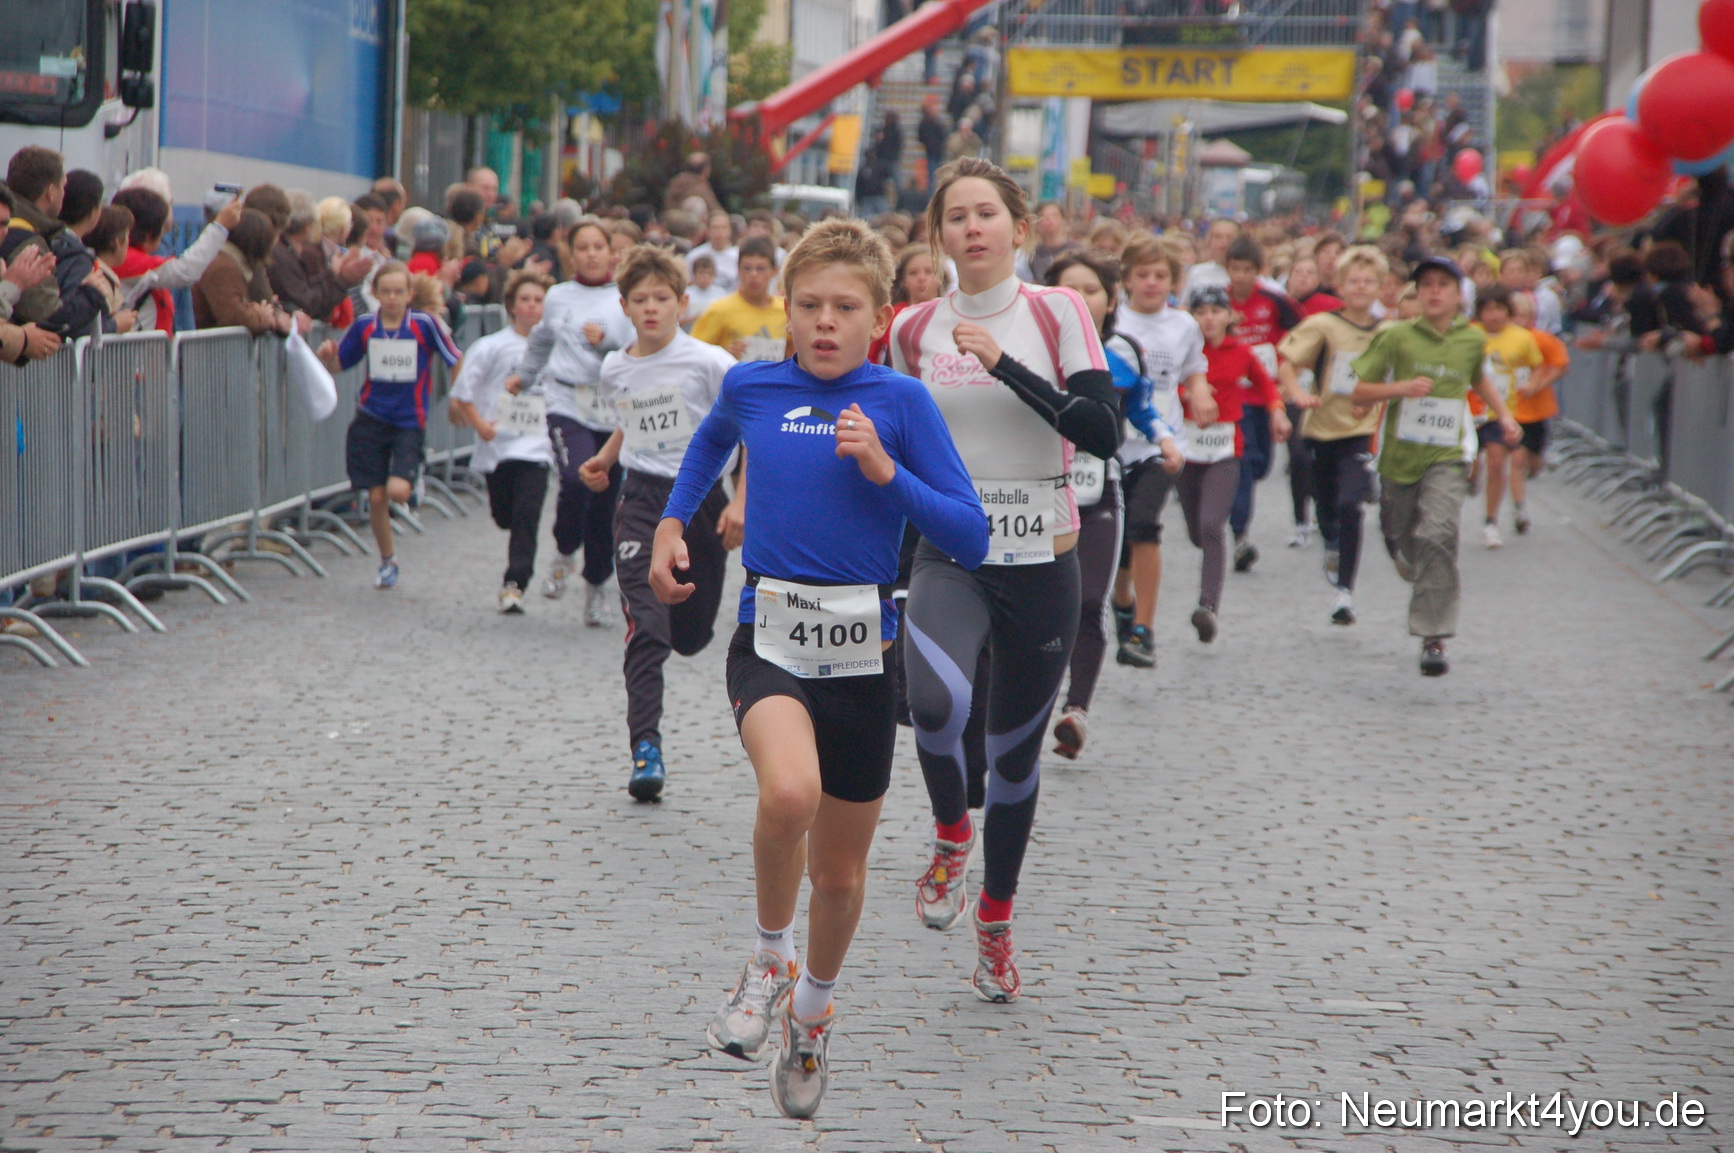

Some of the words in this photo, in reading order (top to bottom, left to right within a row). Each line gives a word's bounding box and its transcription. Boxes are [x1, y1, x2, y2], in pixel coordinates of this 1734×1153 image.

[1120, 56, 1240, 86] START
[632, 393, 674, 410] Alexander
[639, 410, 679, 432] 4127
[780, 421, 836, 435] skinfit
[1417, 414, 1456, 429] 4108
[1196, 434, 1230, 446] 4000
[980, 488, 1030, 505] Isabella
[618, 541, 641, 560] 27
[1015, 551, 1052, 559] PFLEIDERER
[786, 591, 822, 612] Maxi
[759, 615, 767, 628] J
[789, 621, 868, 649] 4100
[832, 658, 880, 671] PFLEIDERER
